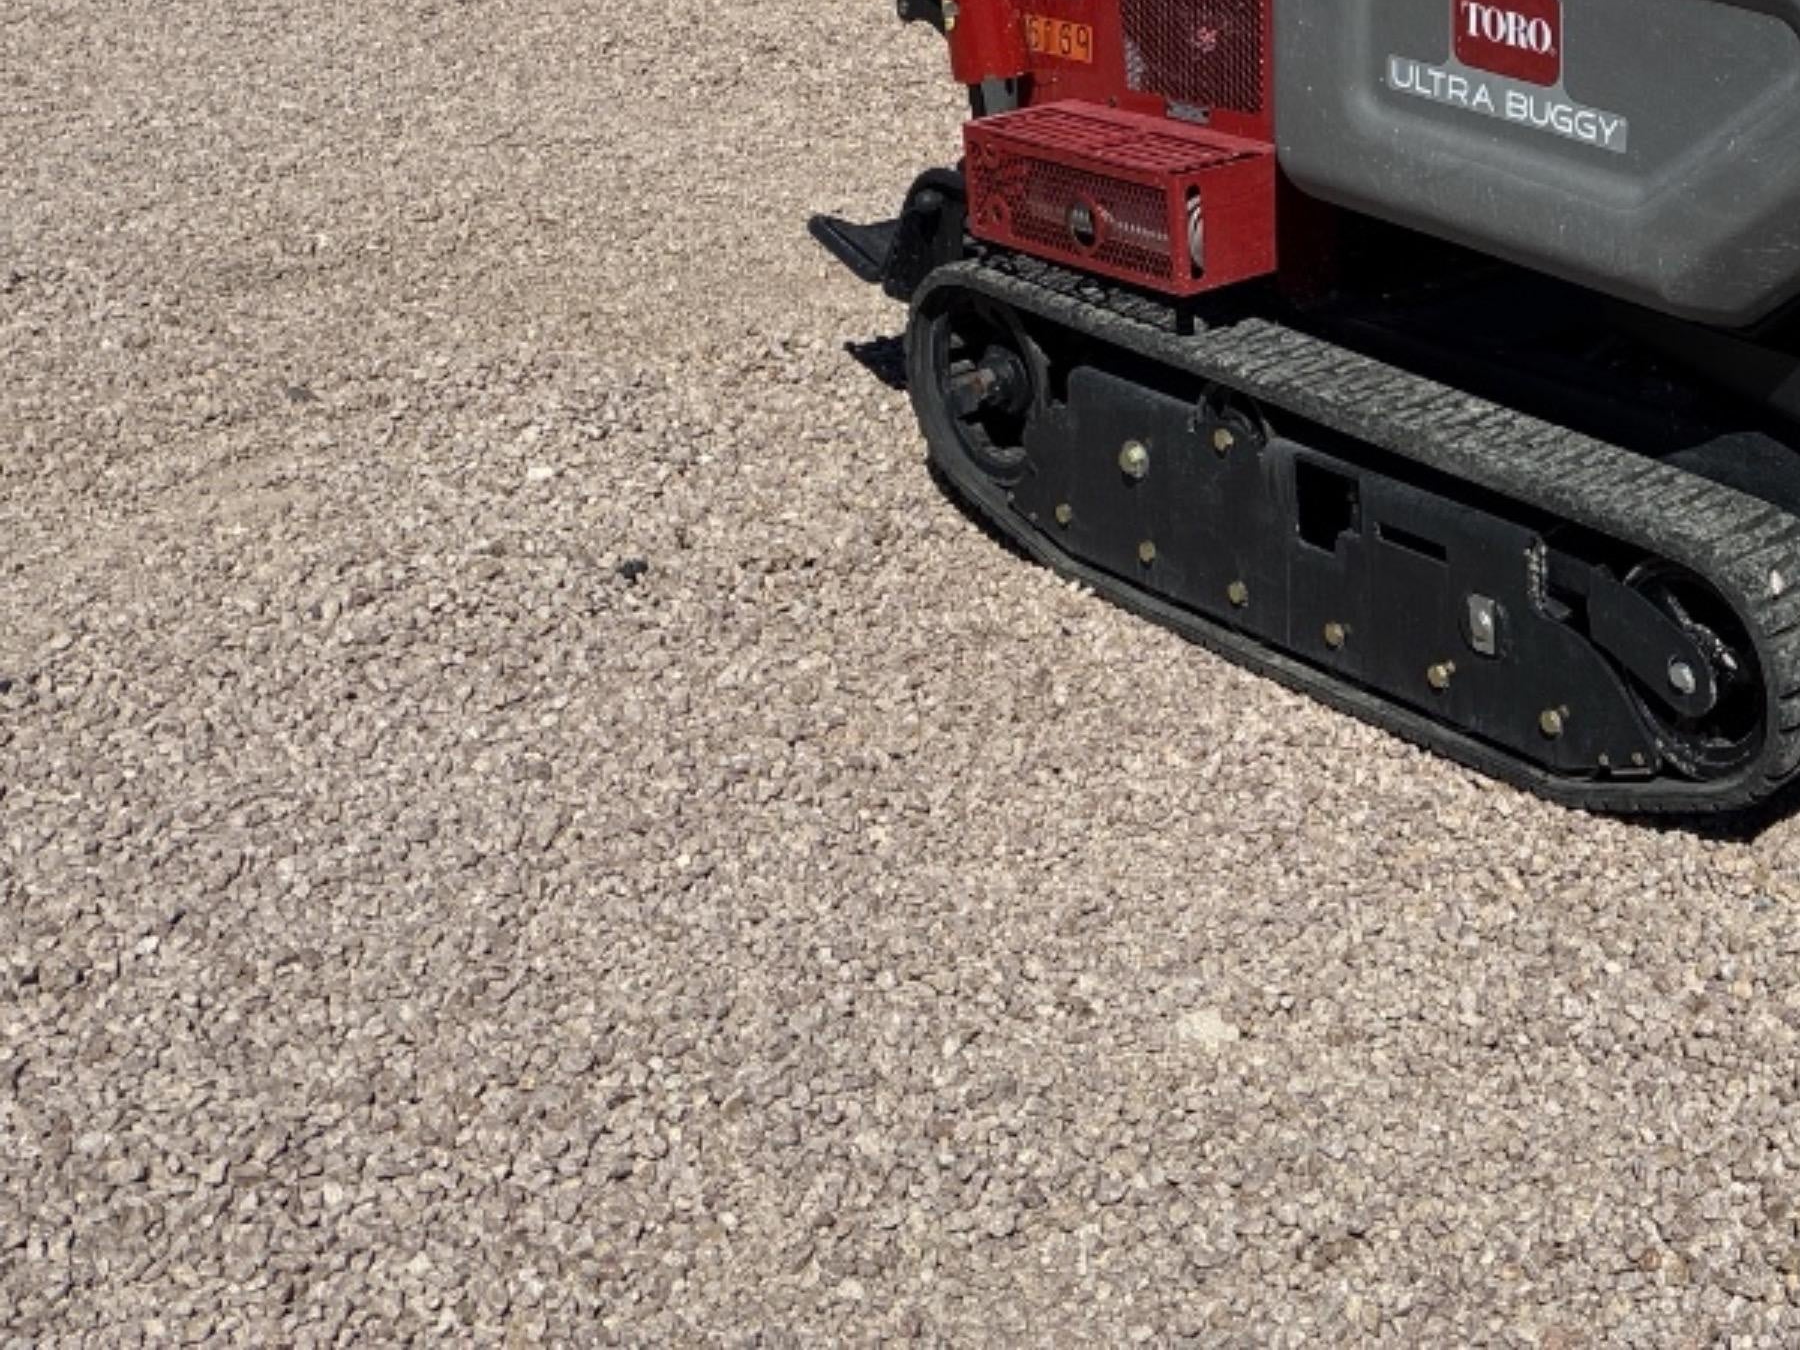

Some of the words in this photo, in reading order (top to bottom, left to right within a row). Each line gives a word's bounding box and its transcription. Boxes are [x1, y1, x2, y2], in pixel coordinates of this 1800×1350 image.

[1460, 0, 1552, 54] TORO
[1390, 57, 1495, 113] ULTRA
[1503, 86, 1619, 146] BUGGY
